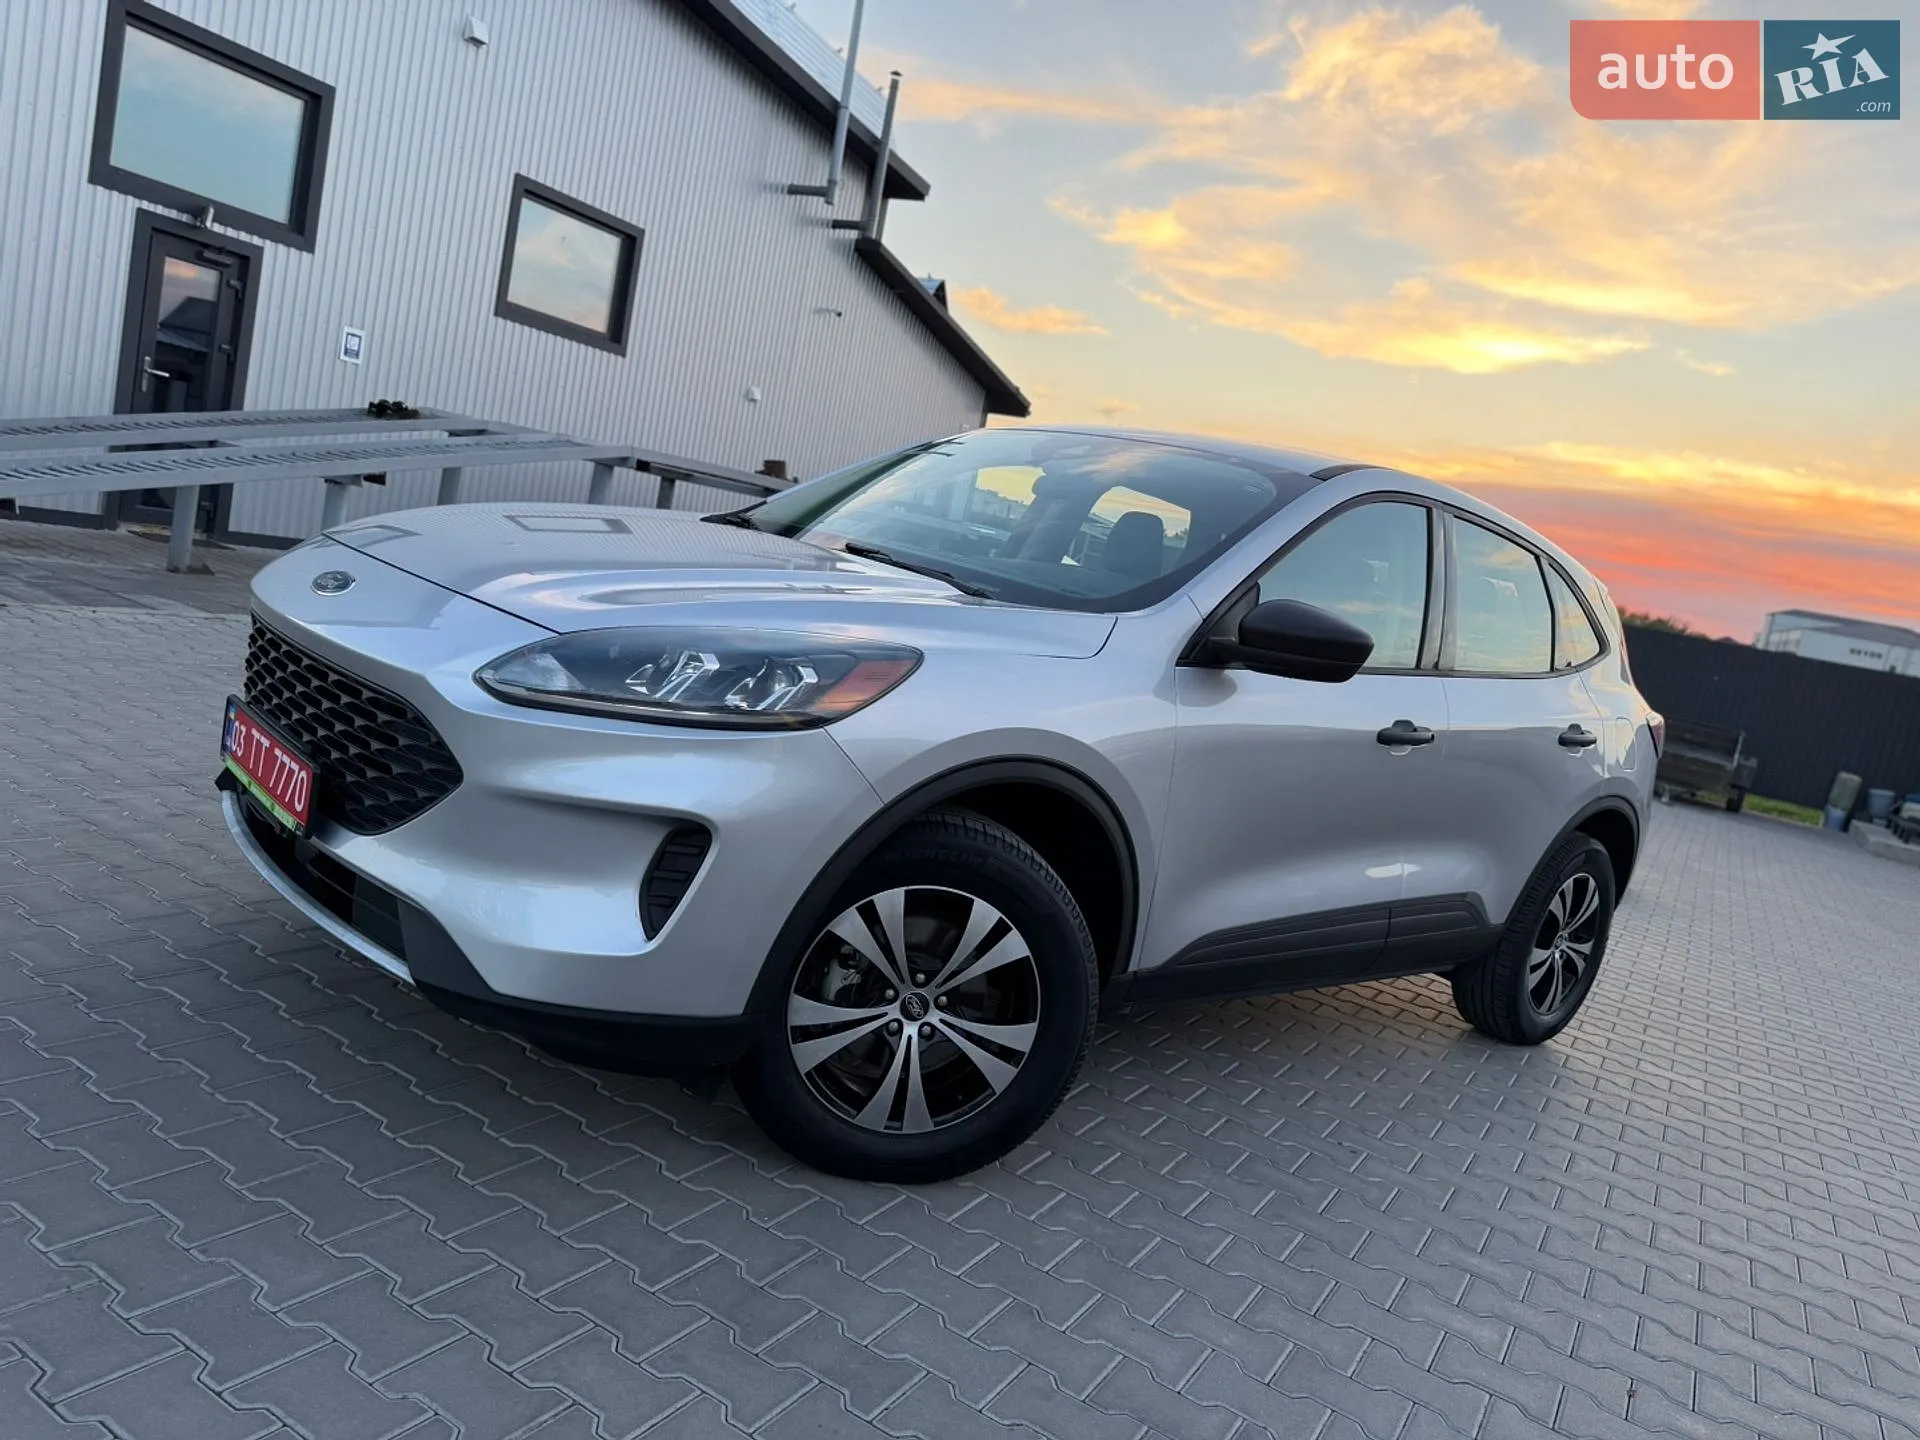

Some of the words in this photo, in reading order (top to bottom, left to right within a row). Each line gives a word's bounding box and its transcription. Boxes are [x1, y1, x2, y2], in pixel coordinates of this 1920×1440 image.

[231, 721, 246, 757] 03
[250, 728, 270, 777] TT
[269, 748, 307, 812] 7770
